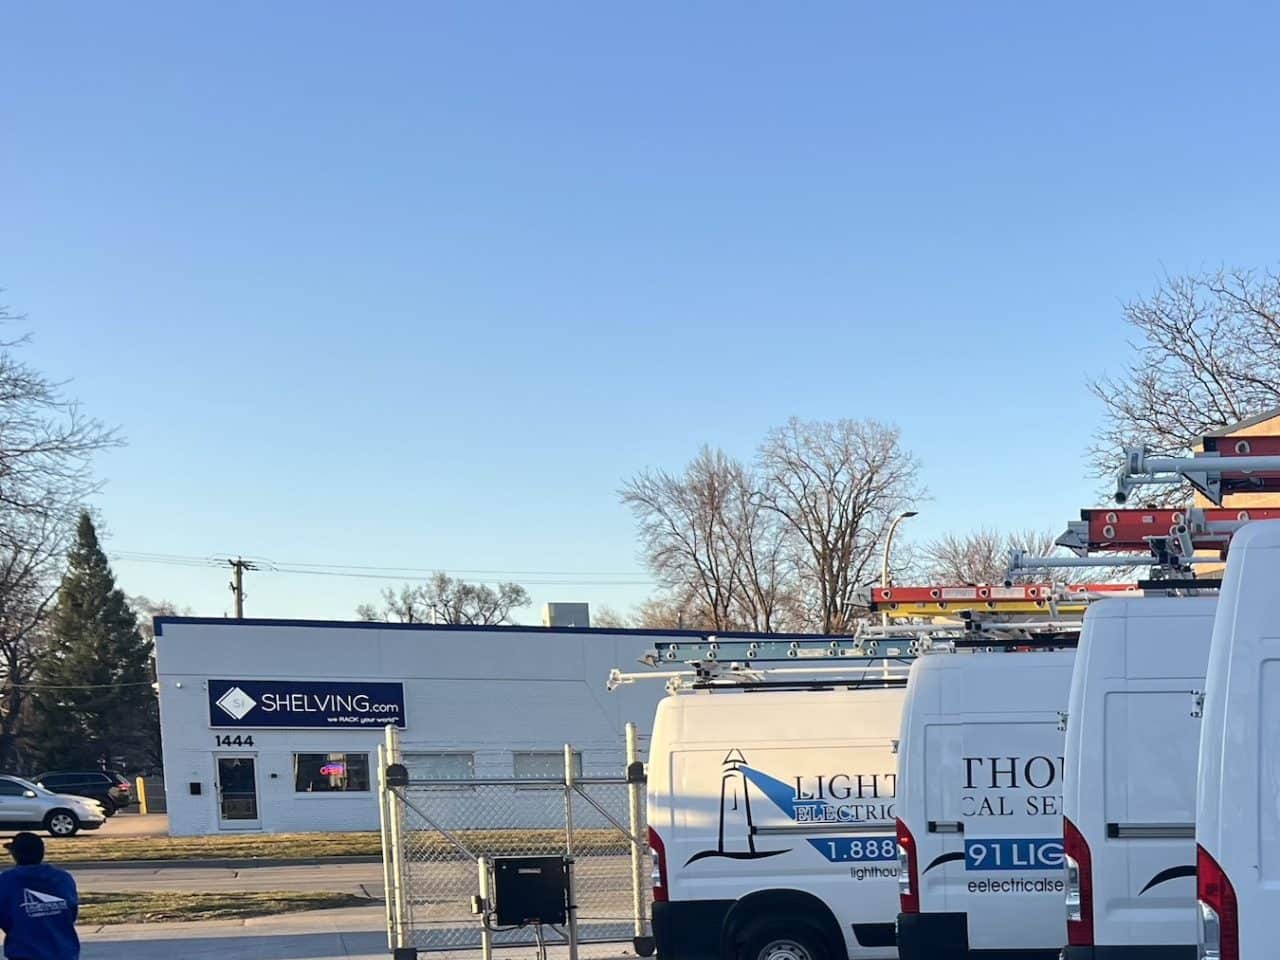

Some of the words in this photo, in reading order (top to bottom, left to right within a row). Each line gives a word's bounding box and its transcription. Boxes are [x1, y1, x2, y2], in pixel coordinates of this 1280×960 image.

[261, 694, 399, 713] SHELVING.com
[215, 735, 255, 747] 1444
[1026, 796, 1063, 816] SE
